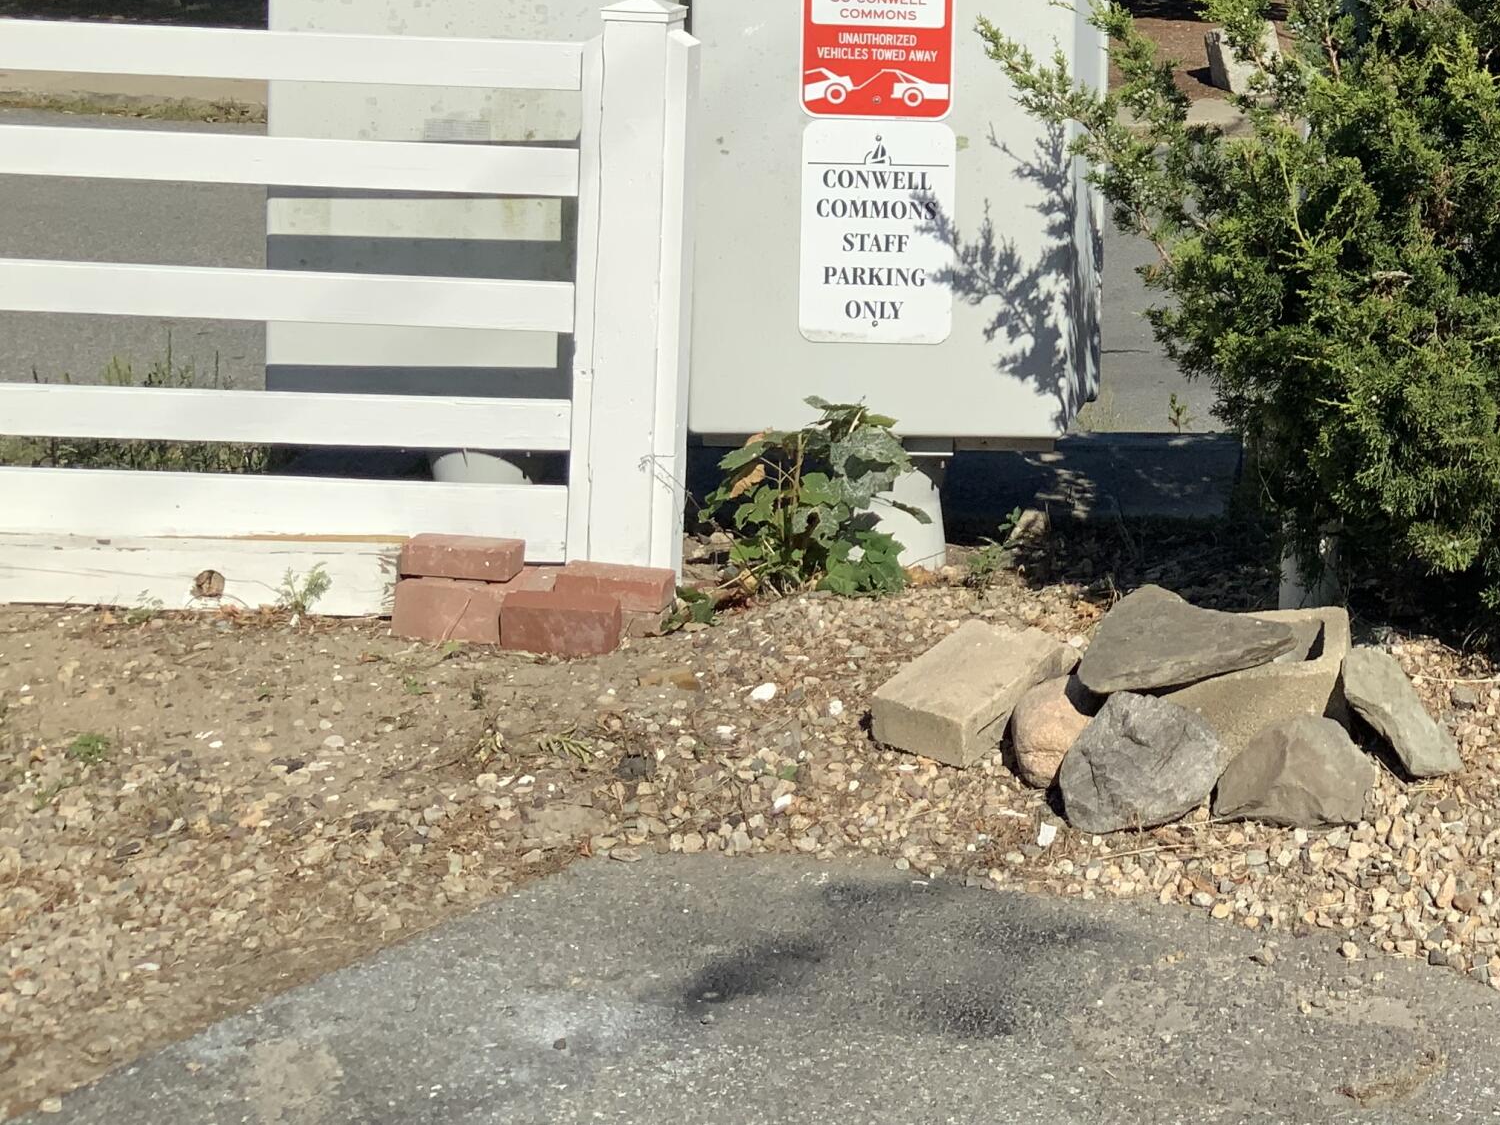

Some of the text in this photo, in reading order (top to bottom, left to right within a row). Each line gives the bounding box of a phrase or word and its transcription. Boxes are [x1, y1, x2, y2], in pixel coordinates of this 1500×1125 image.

[839, 8, 917, 21] COMMONS
[838, 32, 917, 46] UNAUTHORIZED
[817, 47, 938, 62] VEHICLES TOWED AWAY
[822, 169, 932, 191] CONWELL
[816, 198, 937, 220] COMMONS
[842, 233, 910, 253] STAFF
[823, 266, 926, 287] PARKING
[845, 300, 904, 320] ONLY
